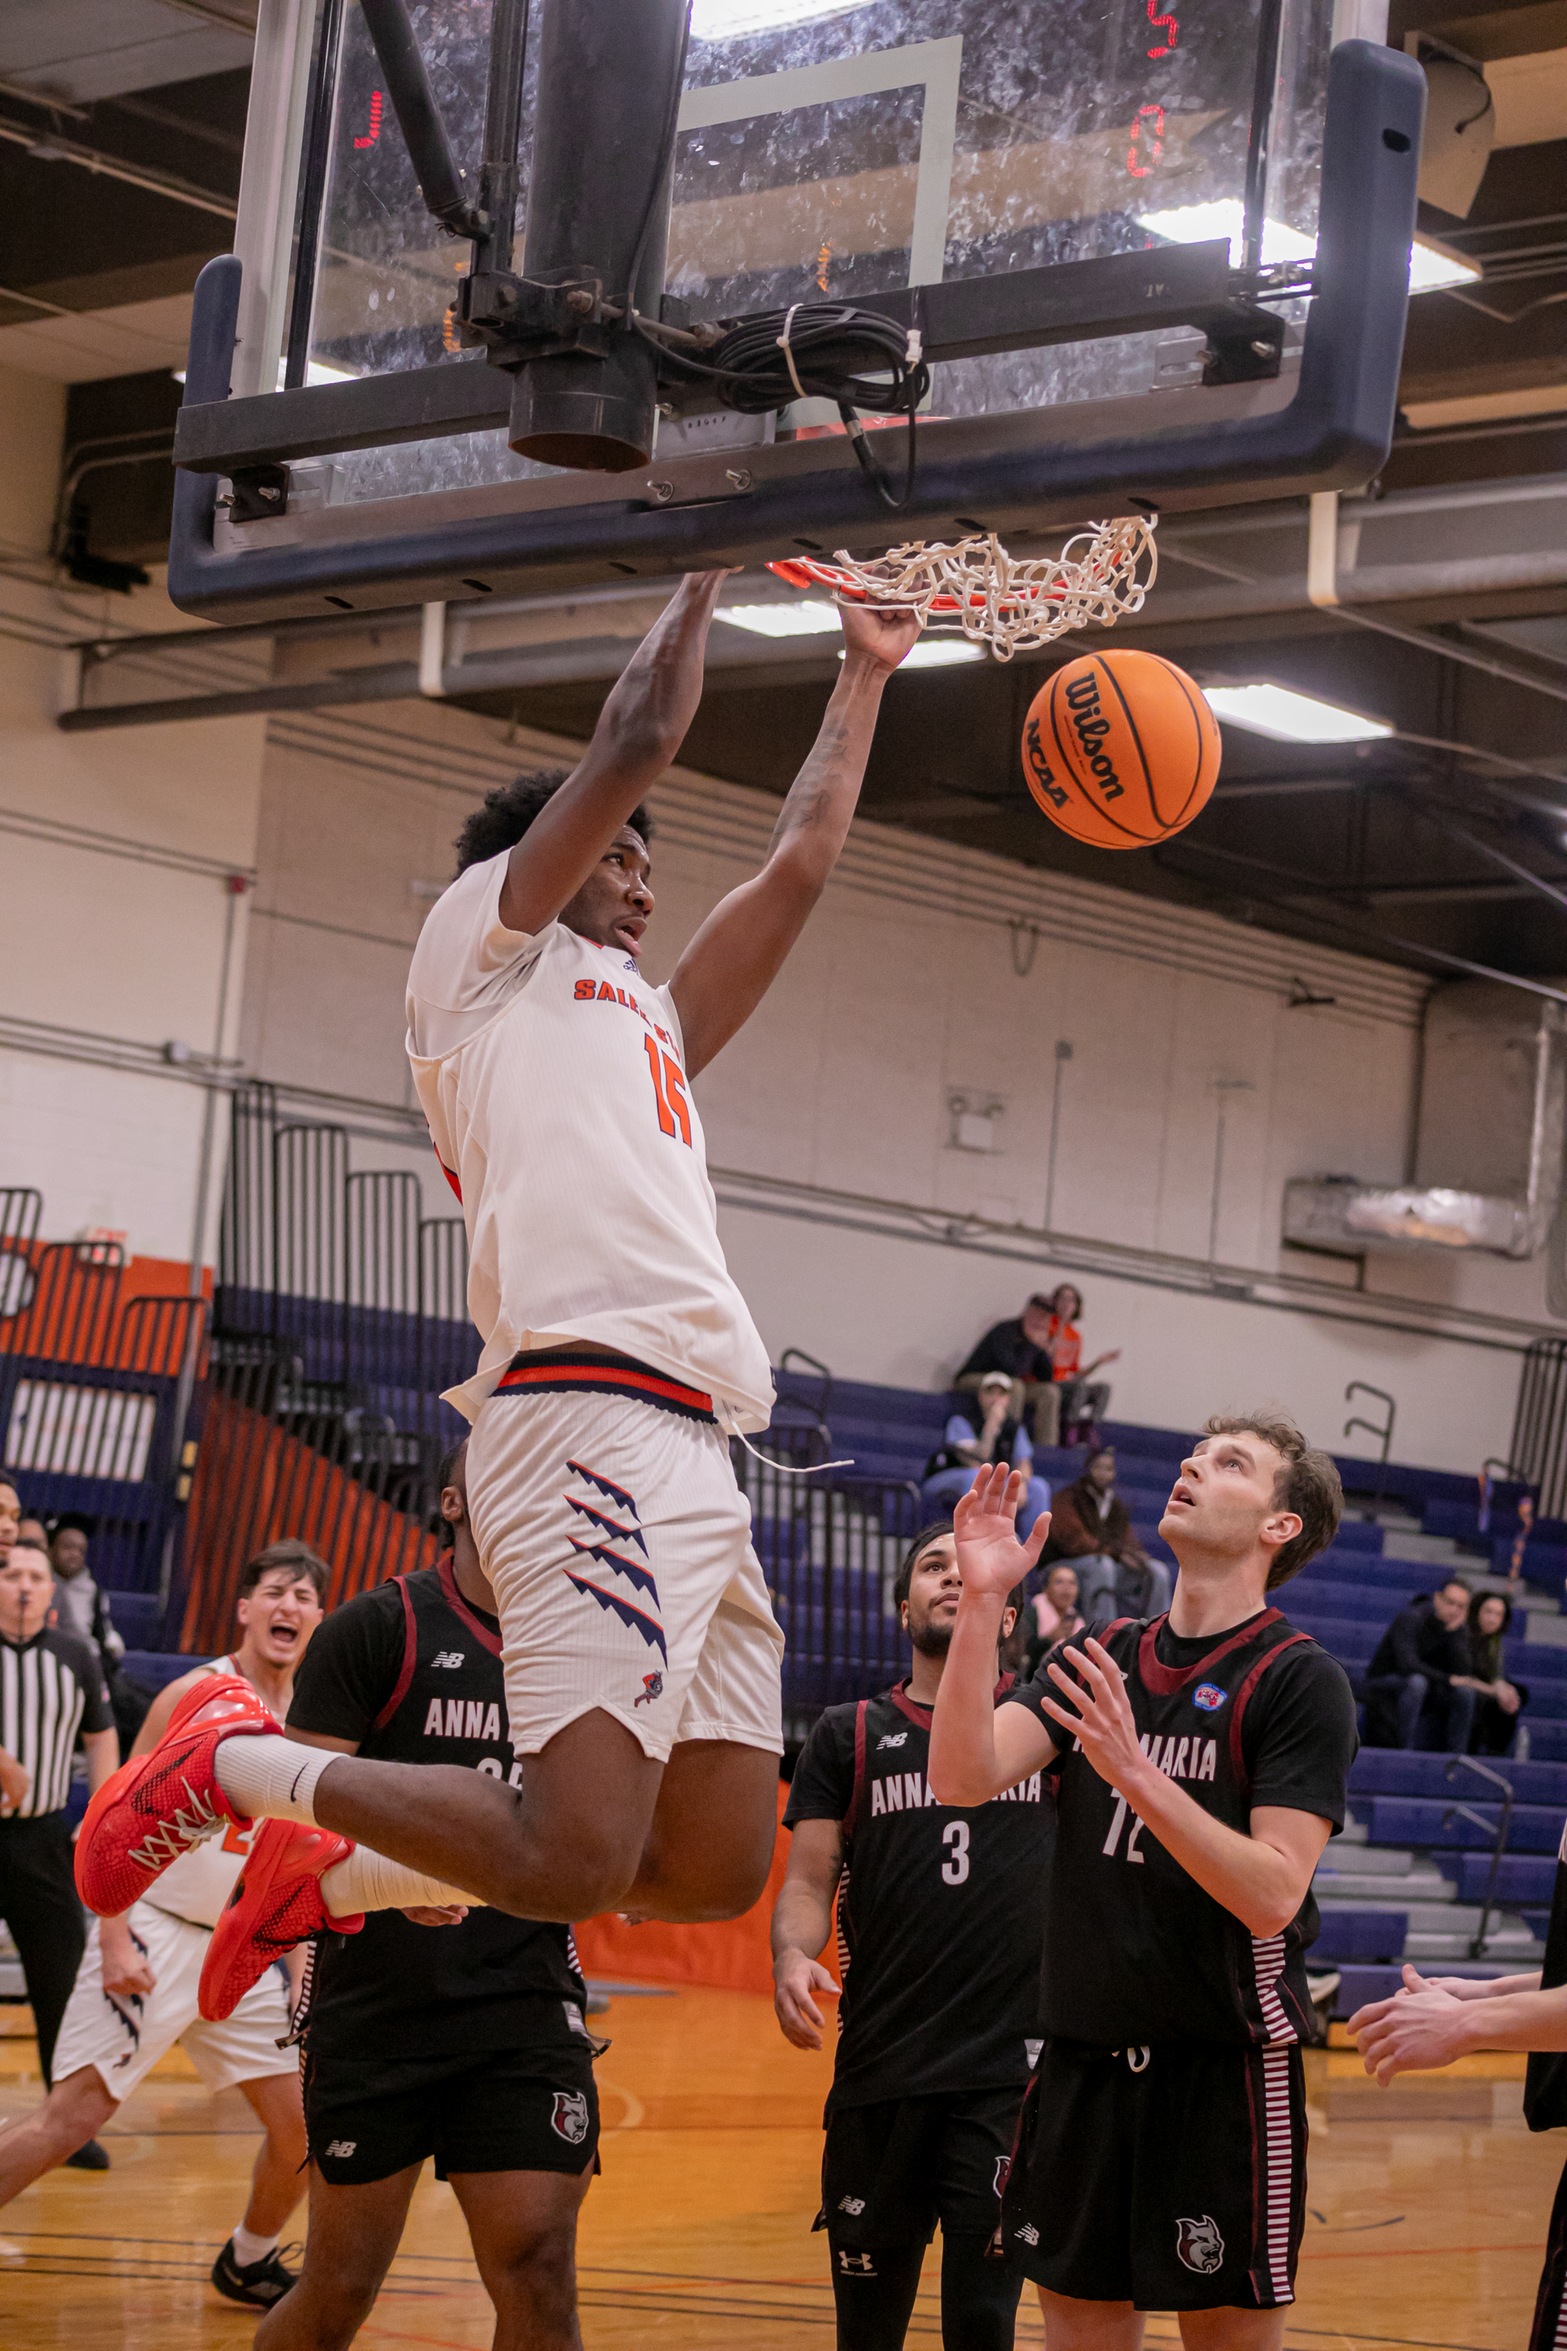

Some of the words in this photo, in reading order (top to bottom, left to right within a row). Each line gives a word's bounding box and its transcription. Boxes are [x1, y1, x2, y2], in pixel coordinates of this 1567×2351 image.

[1026, 717, 1071, 809] NCAA
[1065, 671, 1125, 803] Wilson
[644, 1031, 693, 1149] 15
[423, 1698, 501, 1741] ANNA
[941, 1820, 970, 1886] 3
